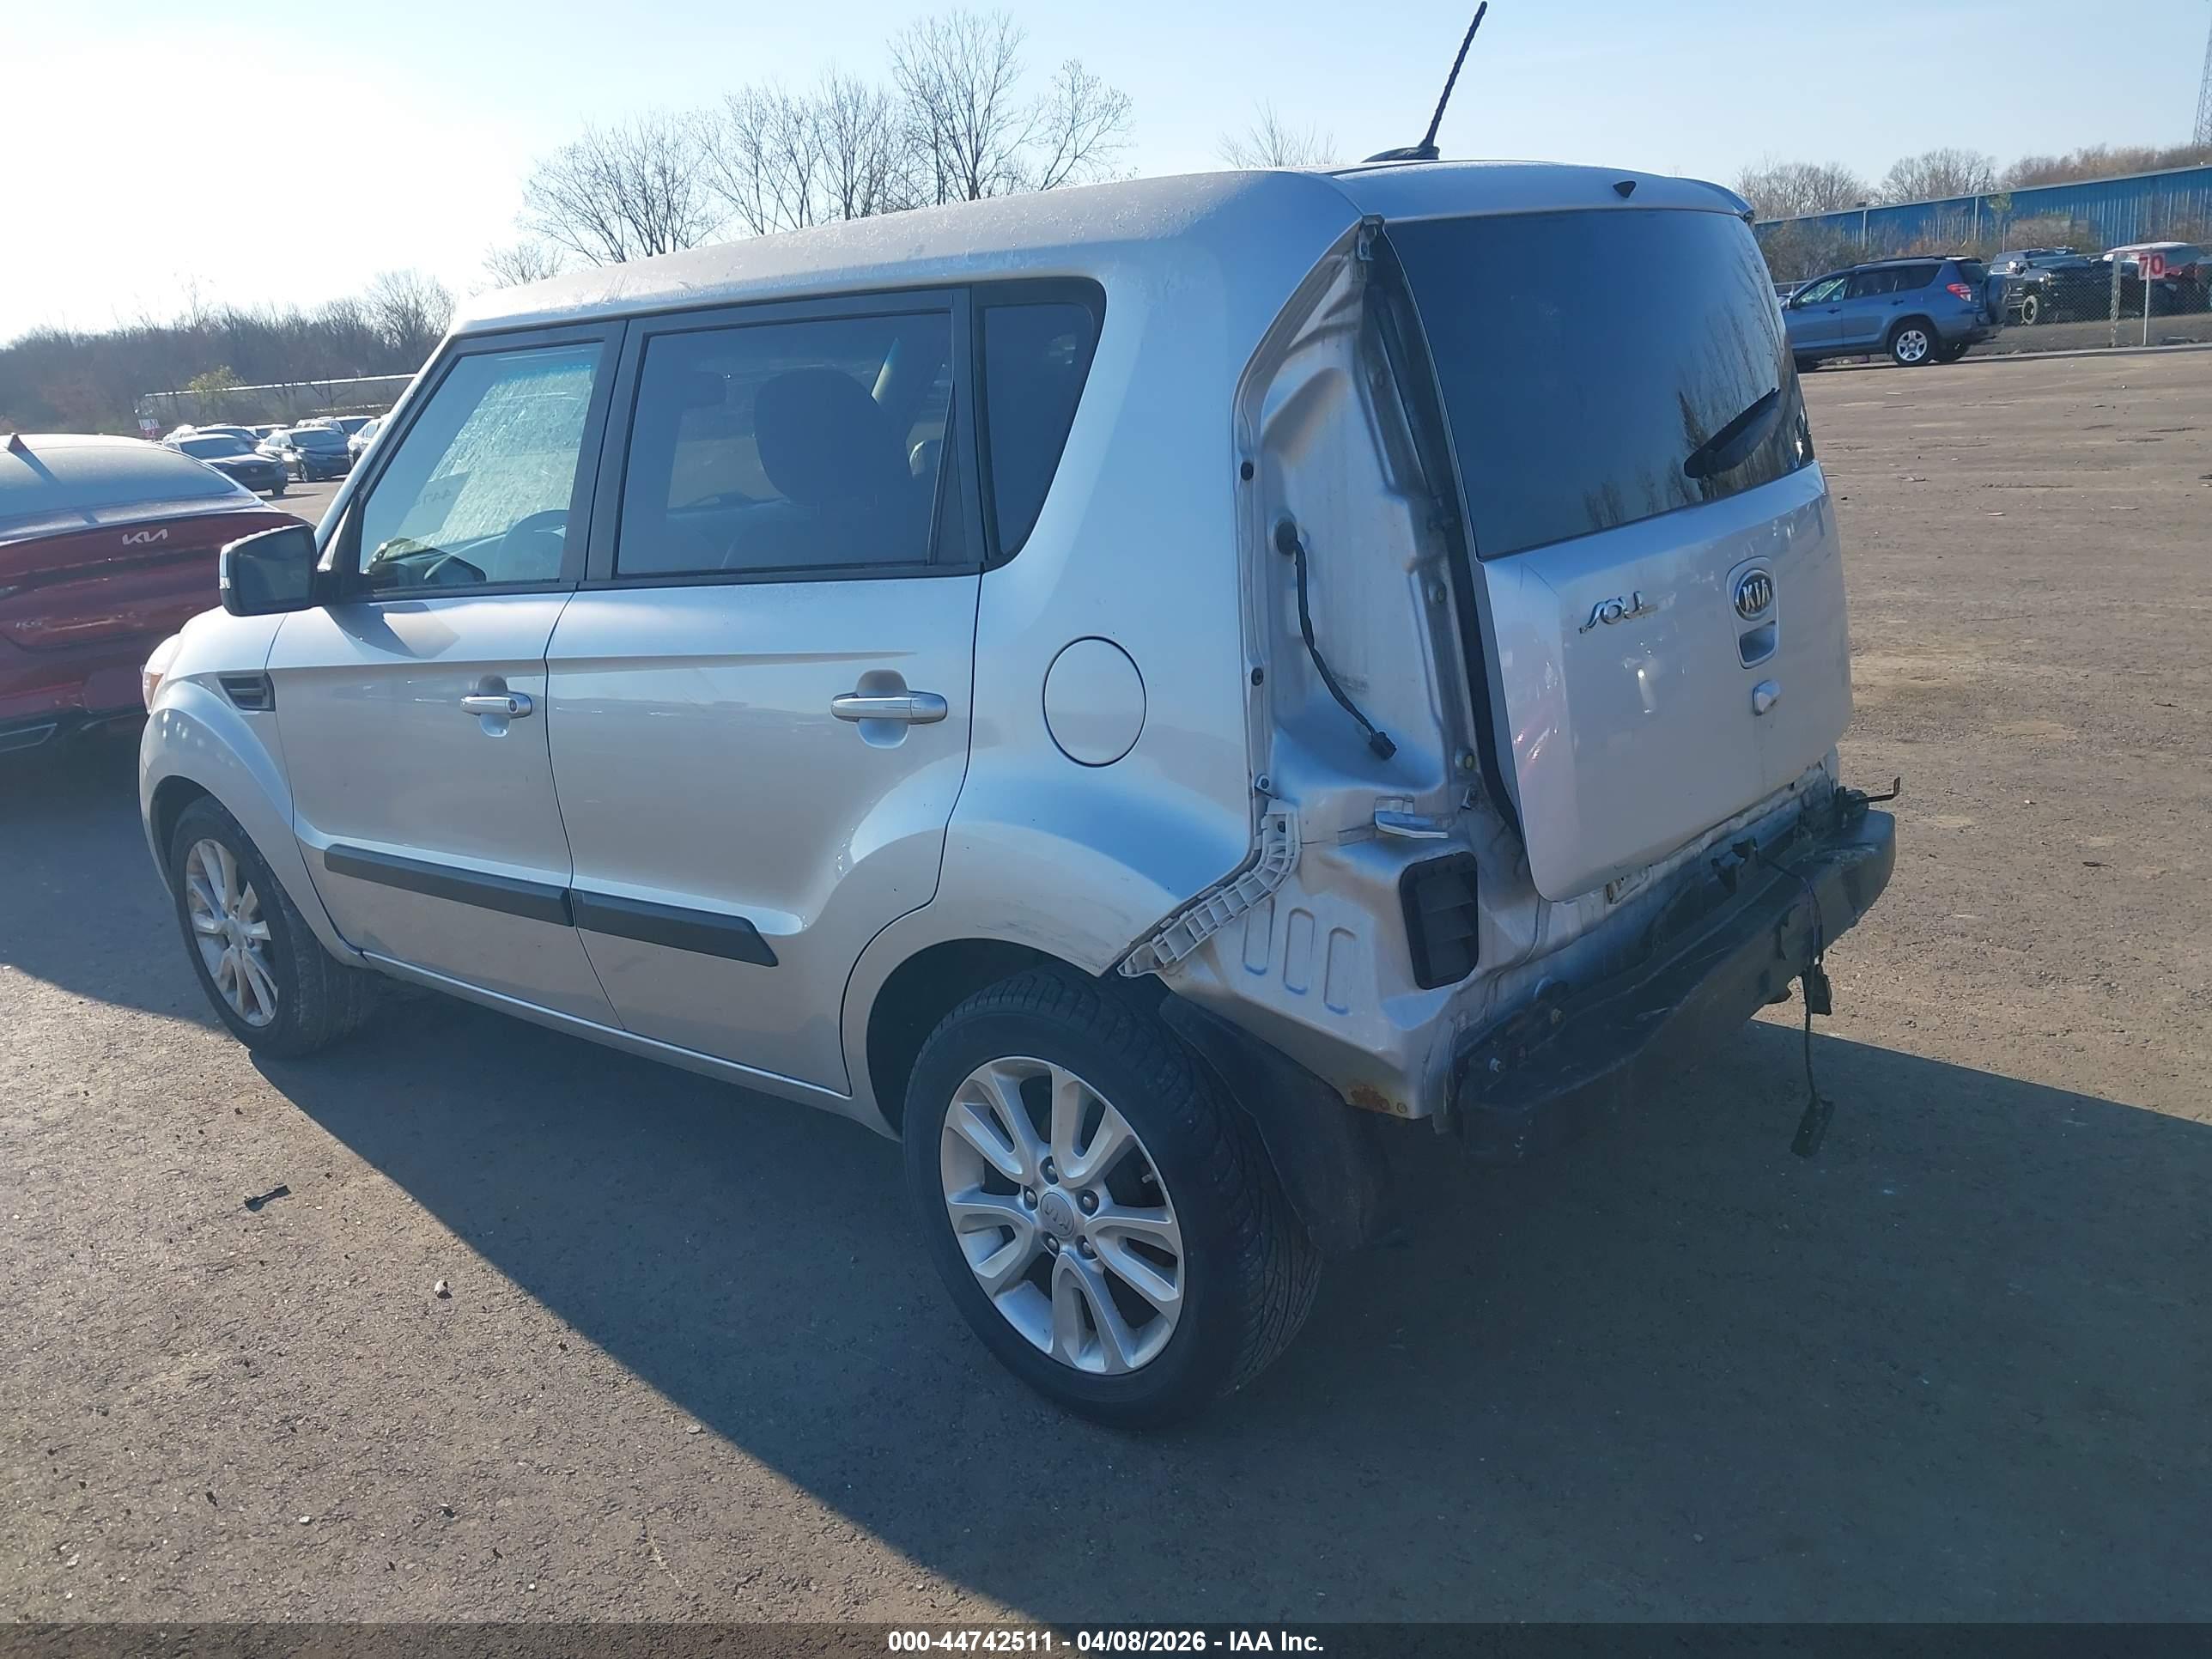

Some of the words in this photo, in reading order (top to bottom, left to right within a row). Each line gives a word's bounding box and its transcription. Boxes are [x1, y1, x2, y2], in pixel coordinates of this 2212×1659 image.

[2138, 254, 2164, 276] 70
[122, 528, 168, 545] KIA
[1741, 577, 1771, 612] KIA
